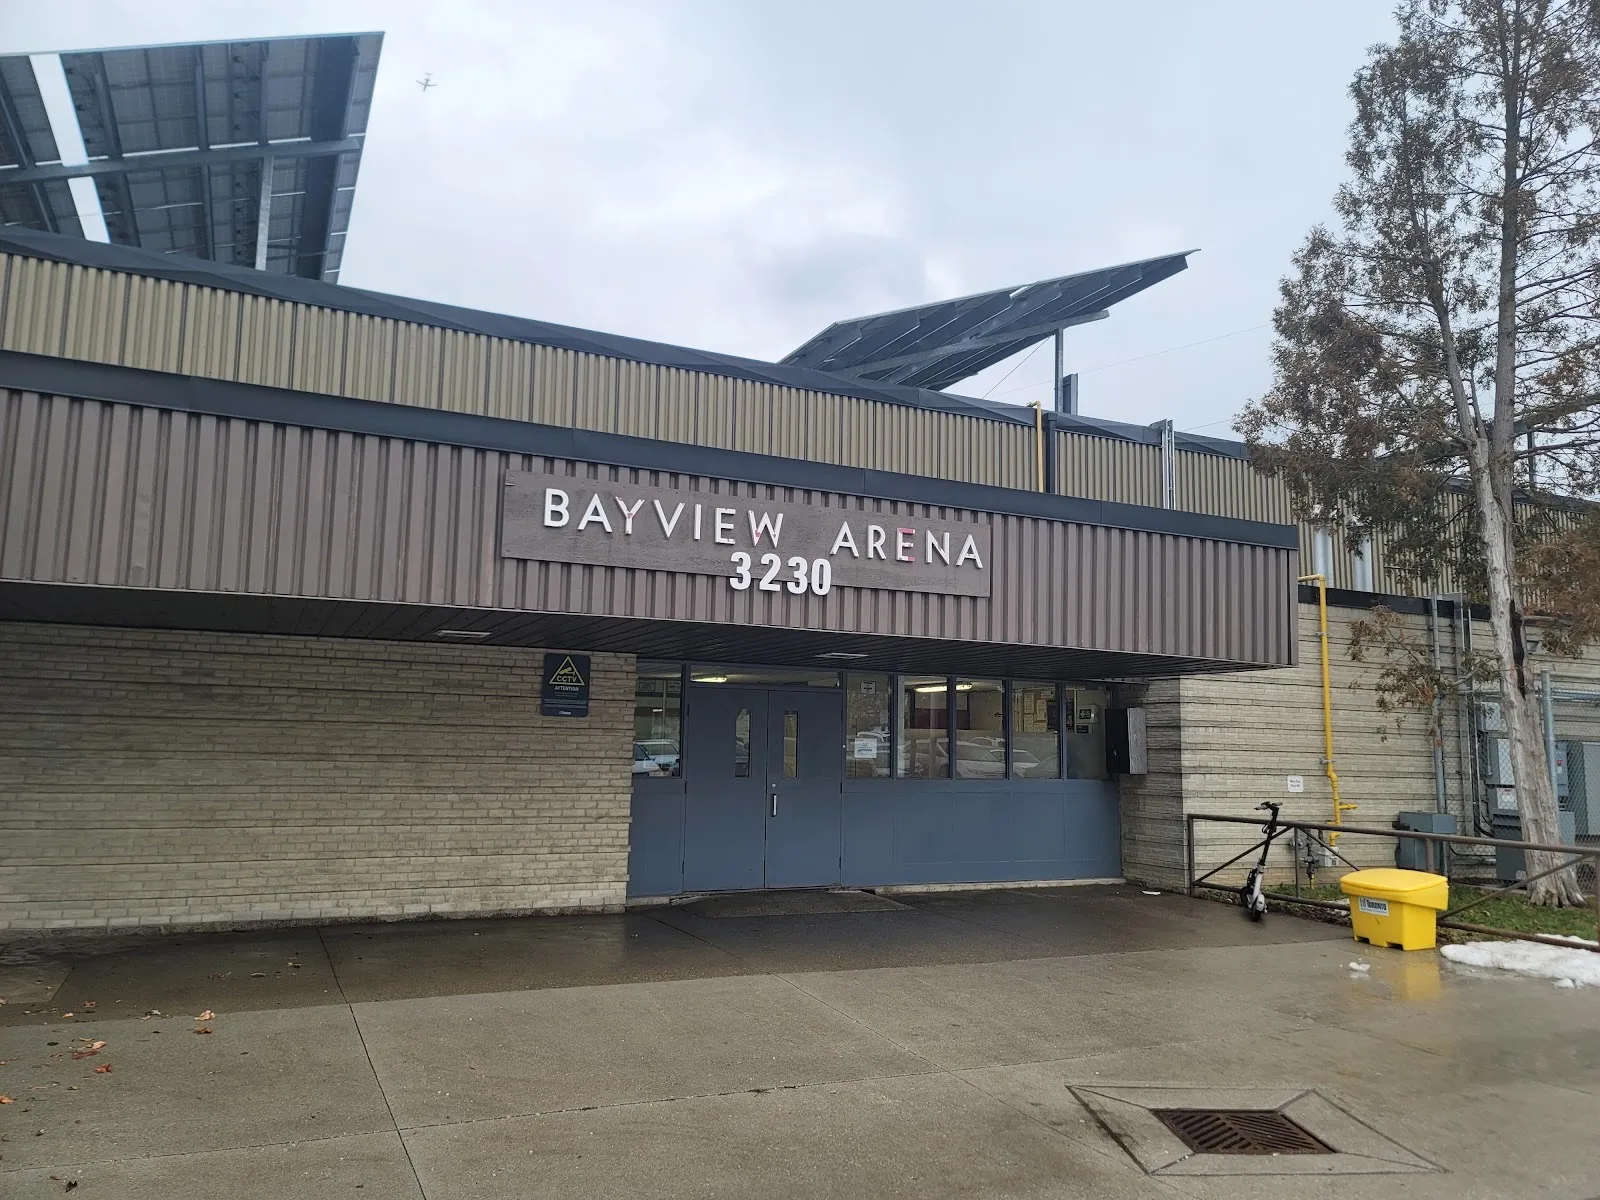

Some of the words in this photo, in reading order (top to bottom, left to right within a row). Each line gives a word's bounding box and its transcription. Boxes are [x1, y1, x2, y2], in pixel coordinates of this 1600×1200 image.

[543, 488, 784, 548] BAYVIEW
[830, 521, 983, 569] ARENA
[729, 551, 832, 596] 3230
[556, 675, 577, 683] CCTV
